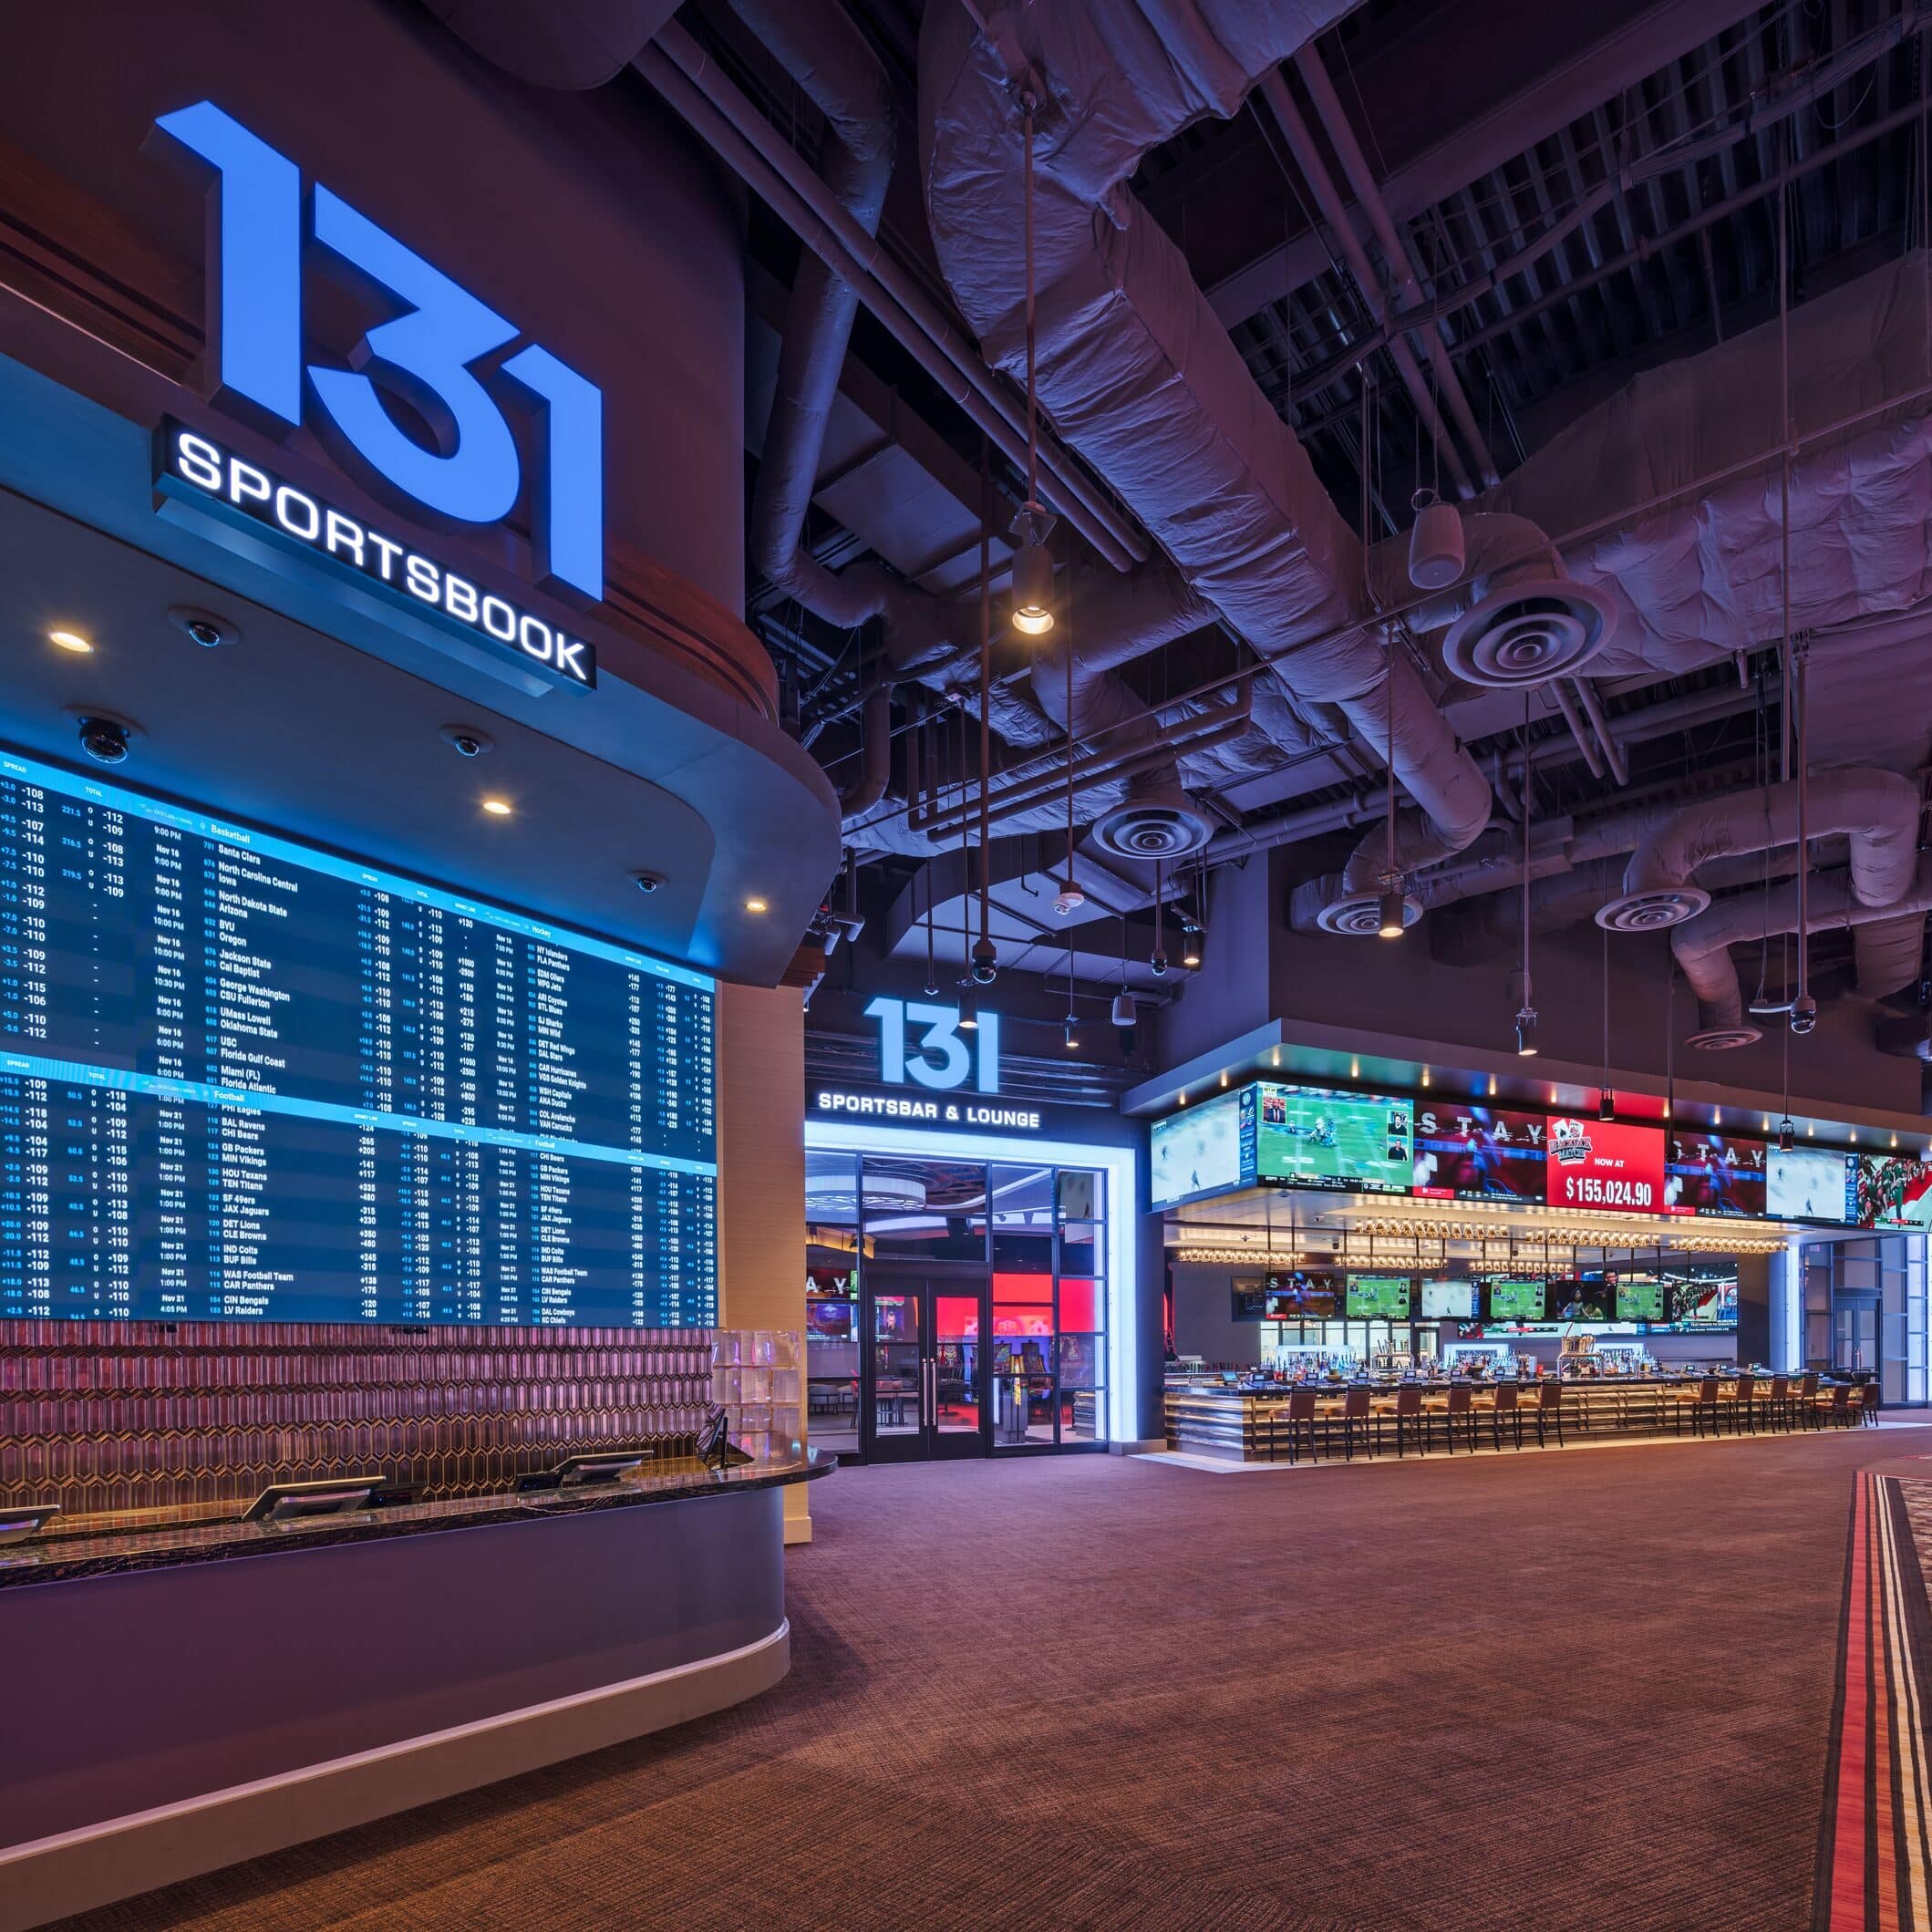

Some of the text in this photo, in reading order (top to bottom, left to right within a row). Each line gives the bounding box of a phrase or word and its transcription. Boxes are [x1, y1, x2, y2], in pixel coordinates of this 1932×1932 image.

[155, 100, 603, 602] 131
[178, 431, 587, 680] SPORTSBOOK
[21, 787, 44, 800] -108
[86, 787, 102, 797] TOTAL
[21, 800, 44, 813] -113
[62, 806, 81, 817] 221.5
[103, 811, 123, 824] -112
[21, 819, 45, 832] -107
[103, 823, 123, 836] -109
[22, 832, 45, 845] -114
[211, 824, 250, 843] Basketball
[62, 837, 81, 848] 216.5
[103, 842, 124, 854] -108
[156, 843, 180, 858] Nov 16
[218, 844, 261, 864] Santa Clara
[22, 852, 45, 864] -110
[103, 855, 124, 867] -113
[22, 864, 45, 877] -110
[63, 869, 82, 880] 219.5
[218, 861, 298, 892] North Carolina Central
[103, 873, 124, 885] -113
[219, 873, 237, 886] Iowa
[23, 883, 45, 897] -112
[103, 885, 124, 898] -109
[23, 897, 45, 909] -109
[219, 890, 288, 917] North Dakota State
[219, 903, 248, 918] Arizona
[23, 916, 46, 928] -110
[219, 919, 235, 932] BYU
[23, 929, 46, 942] -110
[532, 926, 551, 937] Hockey
[219, 932, 247, 946] Oregon
[23, 948, 46, 961] -109
[219, 949, 272, 969] Jackson State
[23, 962, 46, 975] -112
[219, 960, 260, 978] Cal Baptist
[220, 977, 290, 1001] George Washington
[220, 989, 270, 1008] CSU Fullerton
[220, 1007, 271, 1026] UMass Lowell
[220, 1018, 278, 1038] Oklahoma State
[220, 1036, 237, 1048] USC
[538, 1039, 575, 1056] DET Red Wings
[863, 997, 999, 1094] 131
[221, 1048, 285, 1069] Florida Gulf Coast
[221, 1065, 261, 1081] Miami (FL)
[221, 1077, 276, 1094] Florida Atlantic
[568, 1079, 587, 1090] Knights
[214, 1090, 244, 1102] Football
[539, 1110, 576, 1123] COL Avalanche
[819, 1092, 1040, 1129] SPORTSBAR & LOUNGE
[222, 1117, 265, 1131] BAL Ravens
[539, 1119, 573, 1132] VAN Canucks
[222, 1128, 259, 1141] CHI Bears
[222, 1142, 264, 1155] GB Packers
[222, 1153, 267, 1167] MIN Vikings
[1595, 1158, 1625, 1168] NOW AT
[222, 1168, 268, 1181] HOU Texans
[222, 1178, 263, 1191] TEN Titans
[1566, 1176, 1652, 1207] $155,024.90
[222, 1193, 255, 1204] SF 49ers
[222, 1204, 269, 1216] JAX Jaguars
[222, 1218, 261, 1230] DET Lions
[222, 1229, 267, 1241] CLE Browns
[223, 1244, 258, 1255] IND Colts
[223, 1255, 257, 1265] BUF Bills
[223, 1269, 294, 1281] WAS Football Team
[223, 1280, 274, 1290] CAR Panthers
[223, 1295, 269, 1307] CIN Bengals
[224, 1306, 263, 1315] LV Raiders
